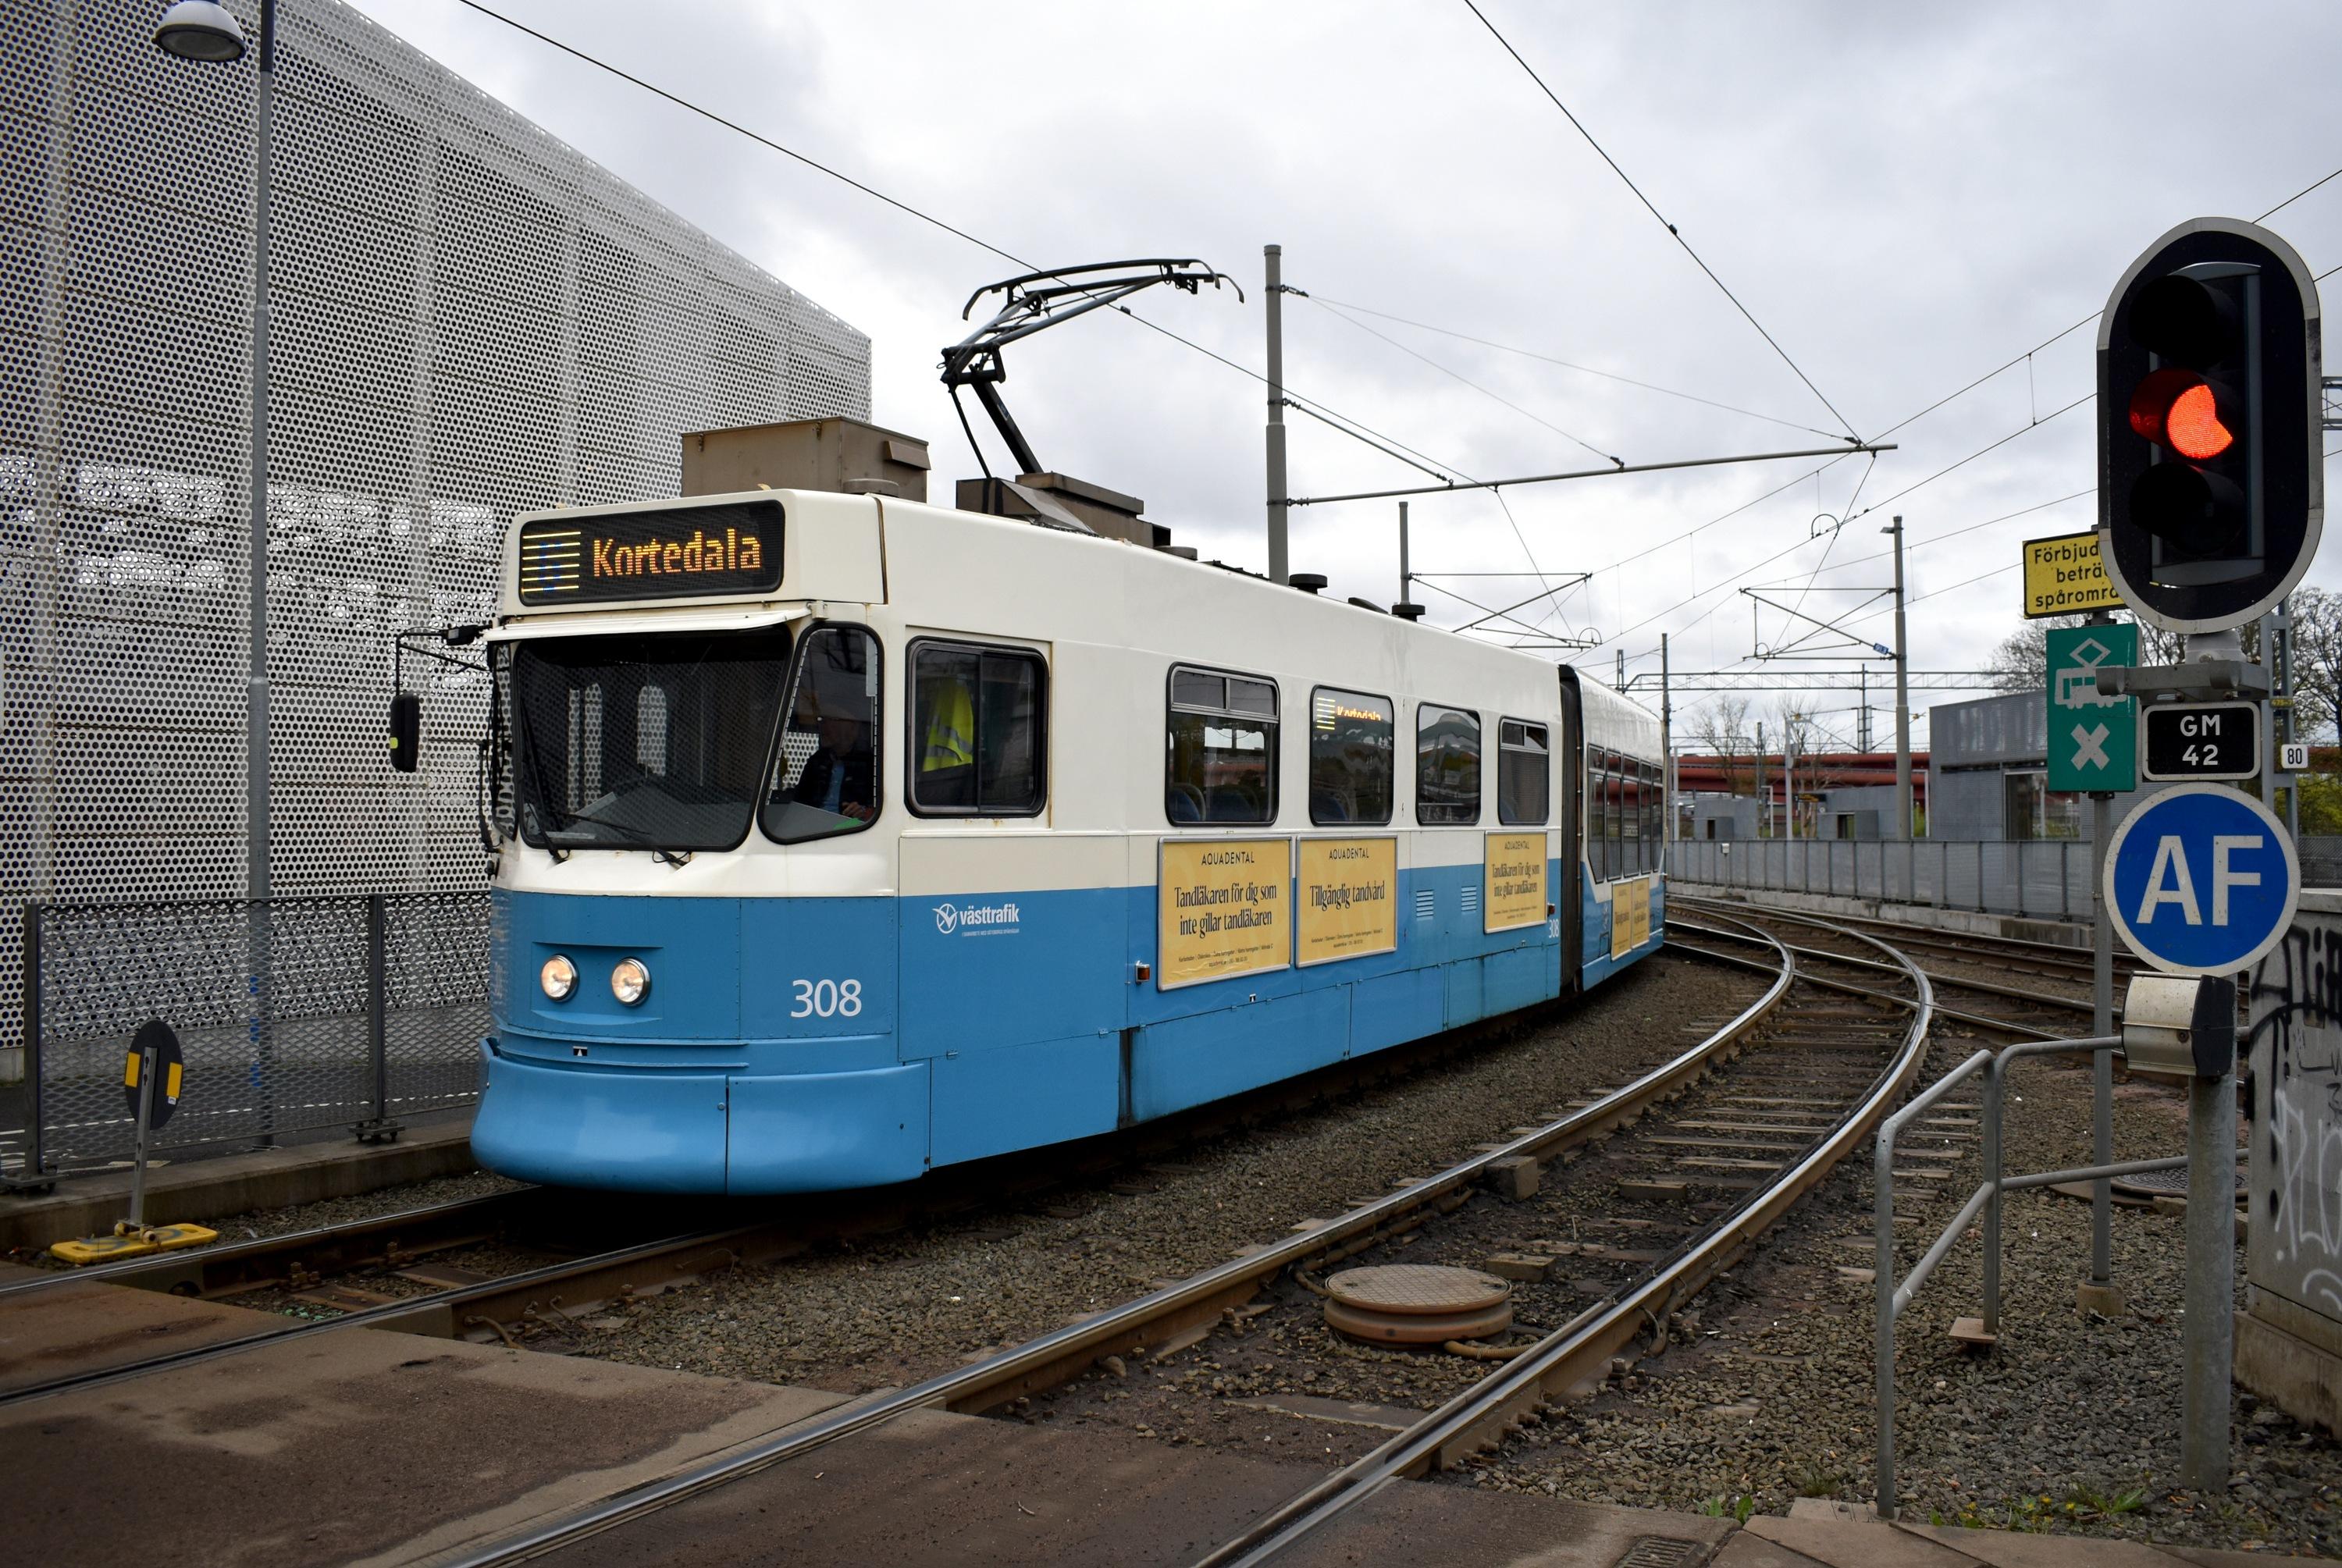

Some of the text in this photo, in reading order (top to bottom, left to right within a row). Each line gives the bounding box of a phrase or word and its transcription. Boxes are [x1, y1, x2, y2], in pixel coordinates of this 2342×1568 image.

[594, 528, 760, 576] Kortedala
[2057, 562, 2108, 583] beträ
[2180, 714, 2220, 737] GM
[2182, 744, 2219, 766] 42
[2287, 748, 2302, 765] 80
[1201, 852, 1255, 866] AQUADENTAL
[1329, 848, 1369, 860] AQUADENTAL
[2136, 835, 2263, 926] AF
[1175, 882, 1276, 908] Tandläkaren för dig som
[1310, 880, 1385, 912] Tillgänglig tandvård
[959, 903, 1020, 926] västtrafik
[1180, 908, 1272, 939] inte gillar tandläkaren
[1549, 918, 1560, 939] 308
[791, 980, 862, 1017] 308
